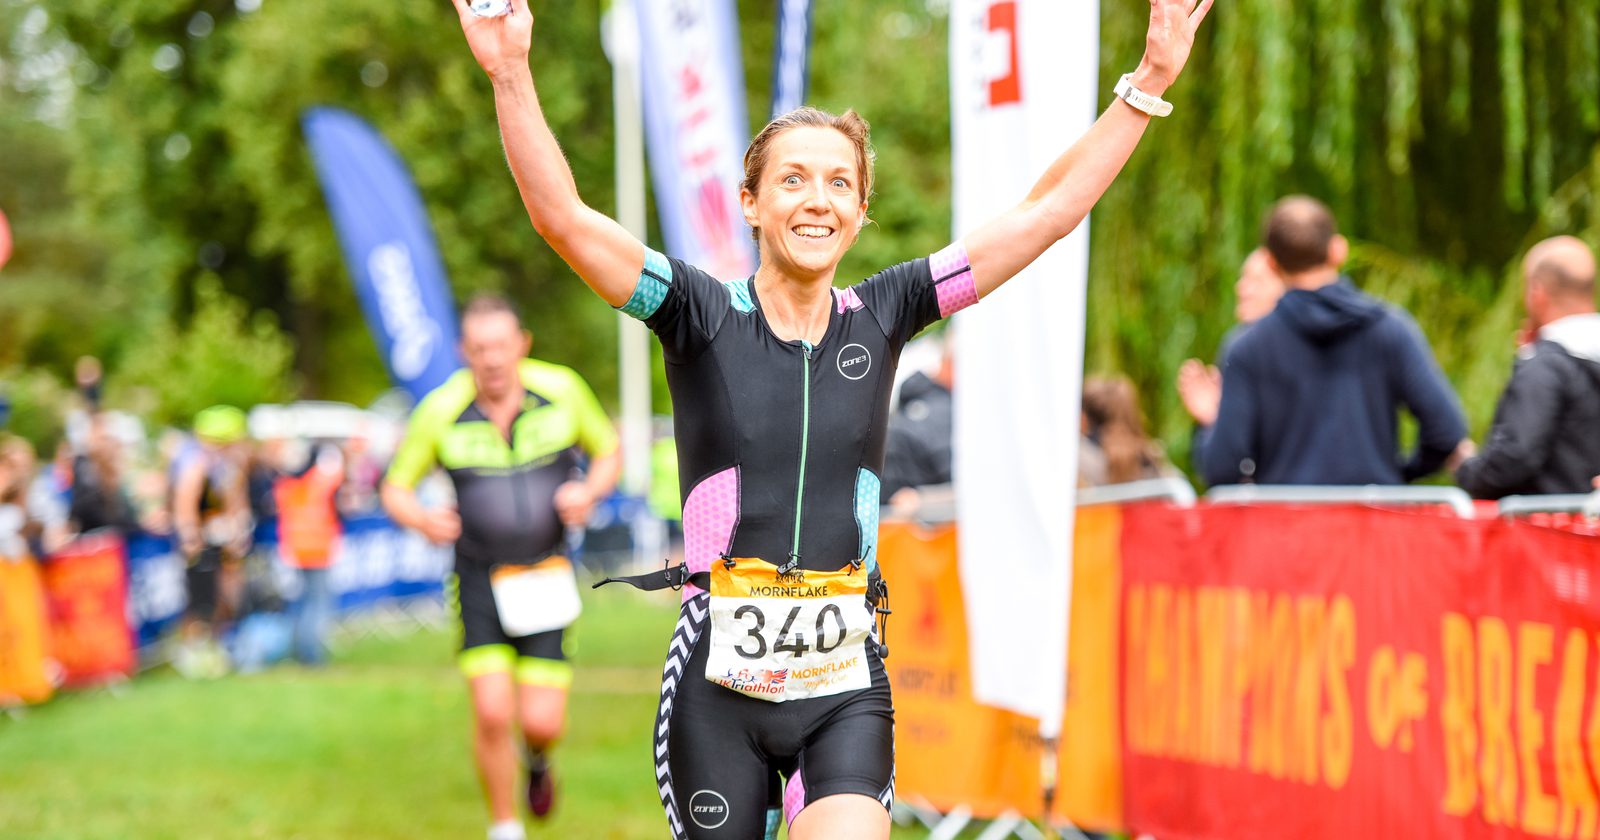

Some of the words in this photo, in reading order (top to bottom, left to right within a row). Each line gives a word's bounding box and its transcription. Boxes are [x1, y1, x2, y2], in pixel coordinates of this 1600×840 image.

[749, 586, 828, 598] MORNFLAKE
[733, 603, 847, 660] 340
[790, 656, 858, 679] MORNFLAKE
[1366, 643, 1429, 754] OF
[1439, 610, 1600, 840] BREA
